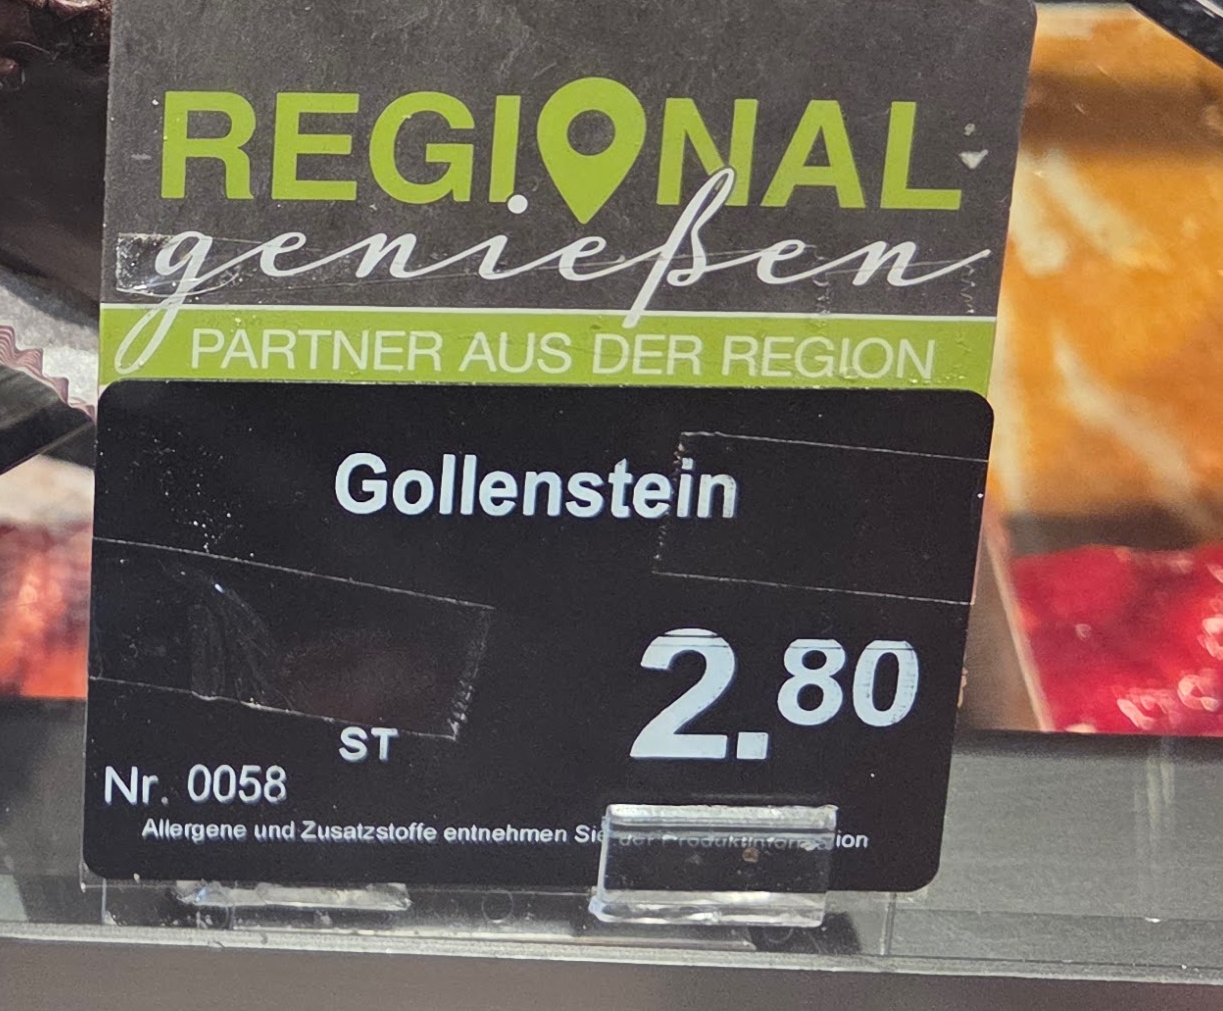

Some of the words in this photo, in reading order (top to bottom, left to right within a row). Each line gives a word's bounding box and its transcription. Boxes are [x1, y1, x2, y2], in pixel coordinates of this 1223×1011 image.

[159, 76, 963, 225] REGIONAL
[114, 167, 991, 375] genießen
[190, 327, 444, 371] PARTNER
[458, 330, 574, 374] AUS
[591, 335, 703, 377] DER
[721, 337, 935, 381] REGION
[334, 452, 737, 521] Gollenstein
[629, 627, 921, 762] 2.80
[338, 726, 398, 762] ST
[103, 766, 168, 805] Nr.
[187, 765, 288, 804] 0058
[141, 817, 247, 843] Allergene
[254, 819, 296, 840] und
[301, 820, 438, 842] Zusatzstoffe
[444, 822, 568, 843] entnehmen
